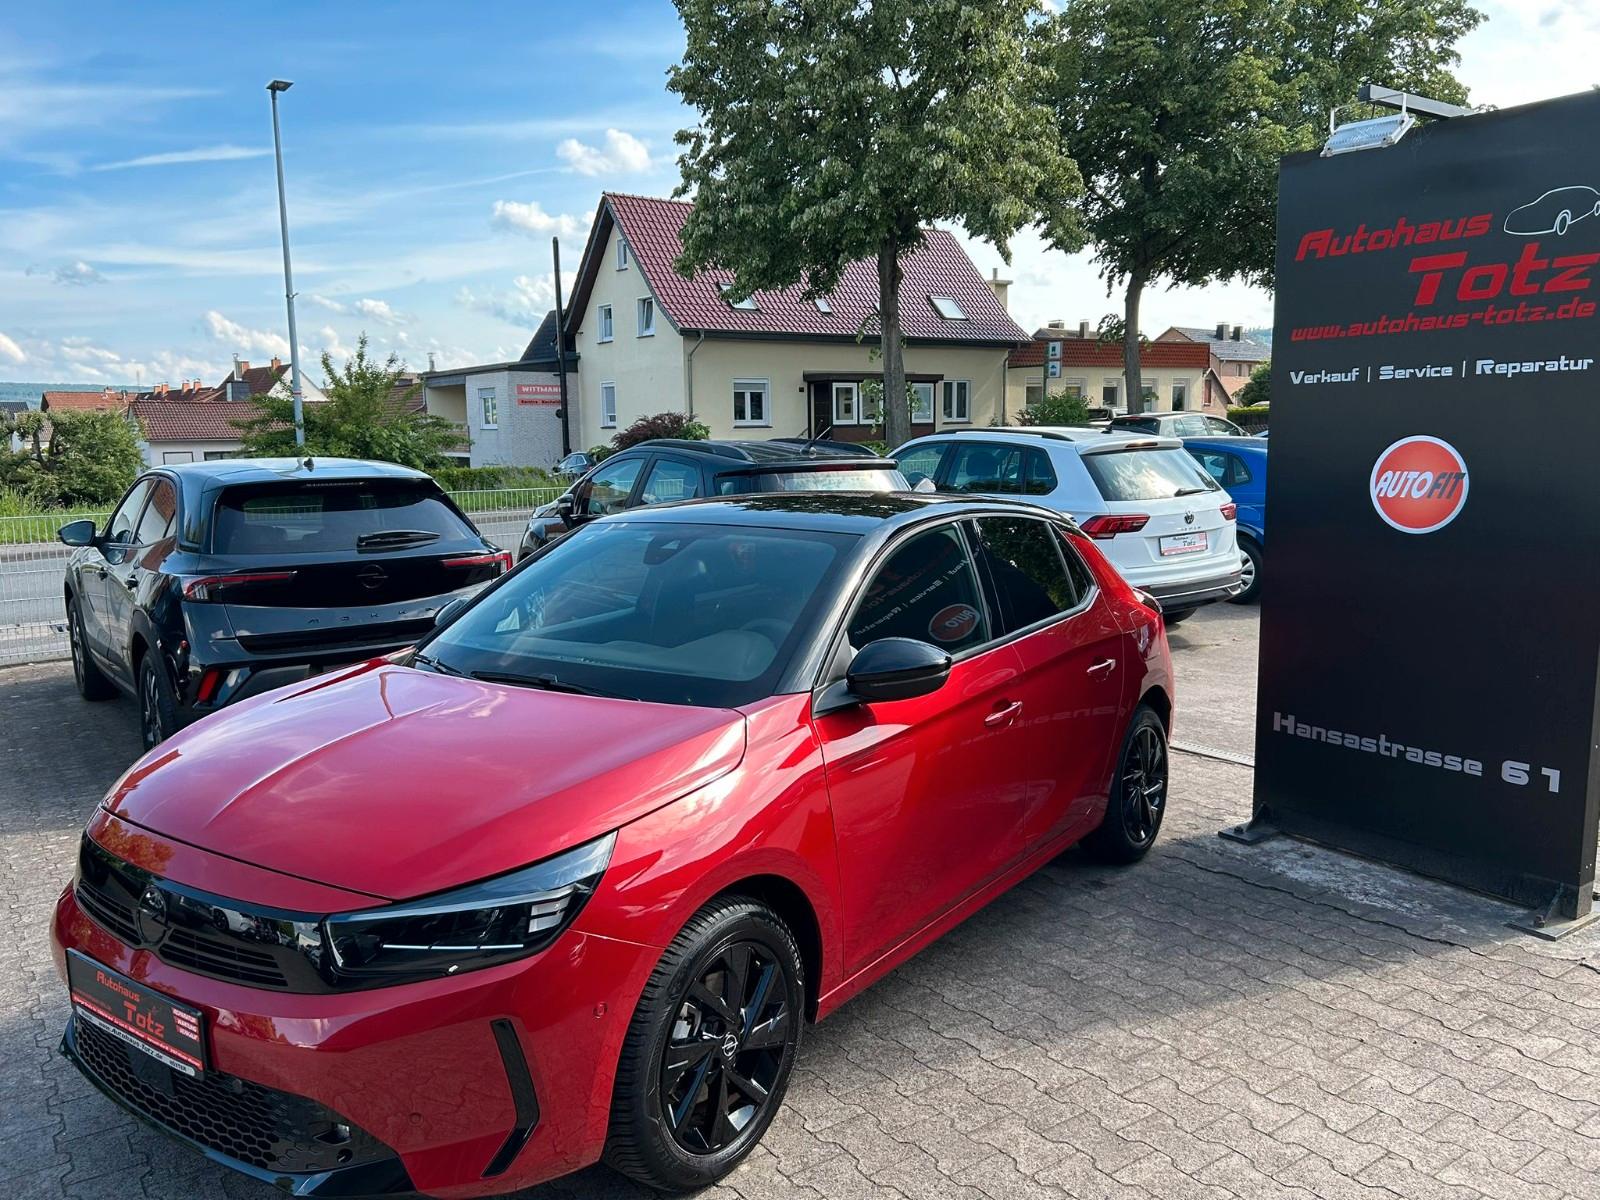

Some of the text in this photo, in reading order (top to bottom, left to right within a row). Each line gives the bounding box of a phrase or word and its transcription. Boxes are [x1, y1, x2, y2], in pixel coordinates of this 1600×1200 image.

[1294, 213, 1493, 262] Autohaus
[1408, 242, 1600, 306] Totz
[1290, 297, 1597, 342] www.autohaus-totz.de
[1289, 355, 1594, 385] Verkauf Service Reparatur
[1375, 470, 1467, 499] AUTOFIT
[1272, 711, 1483, 777] Hansastrasse
[96, 970, 140, 1002] Autohaus
[123, 1000, 165, 1038] Totz
